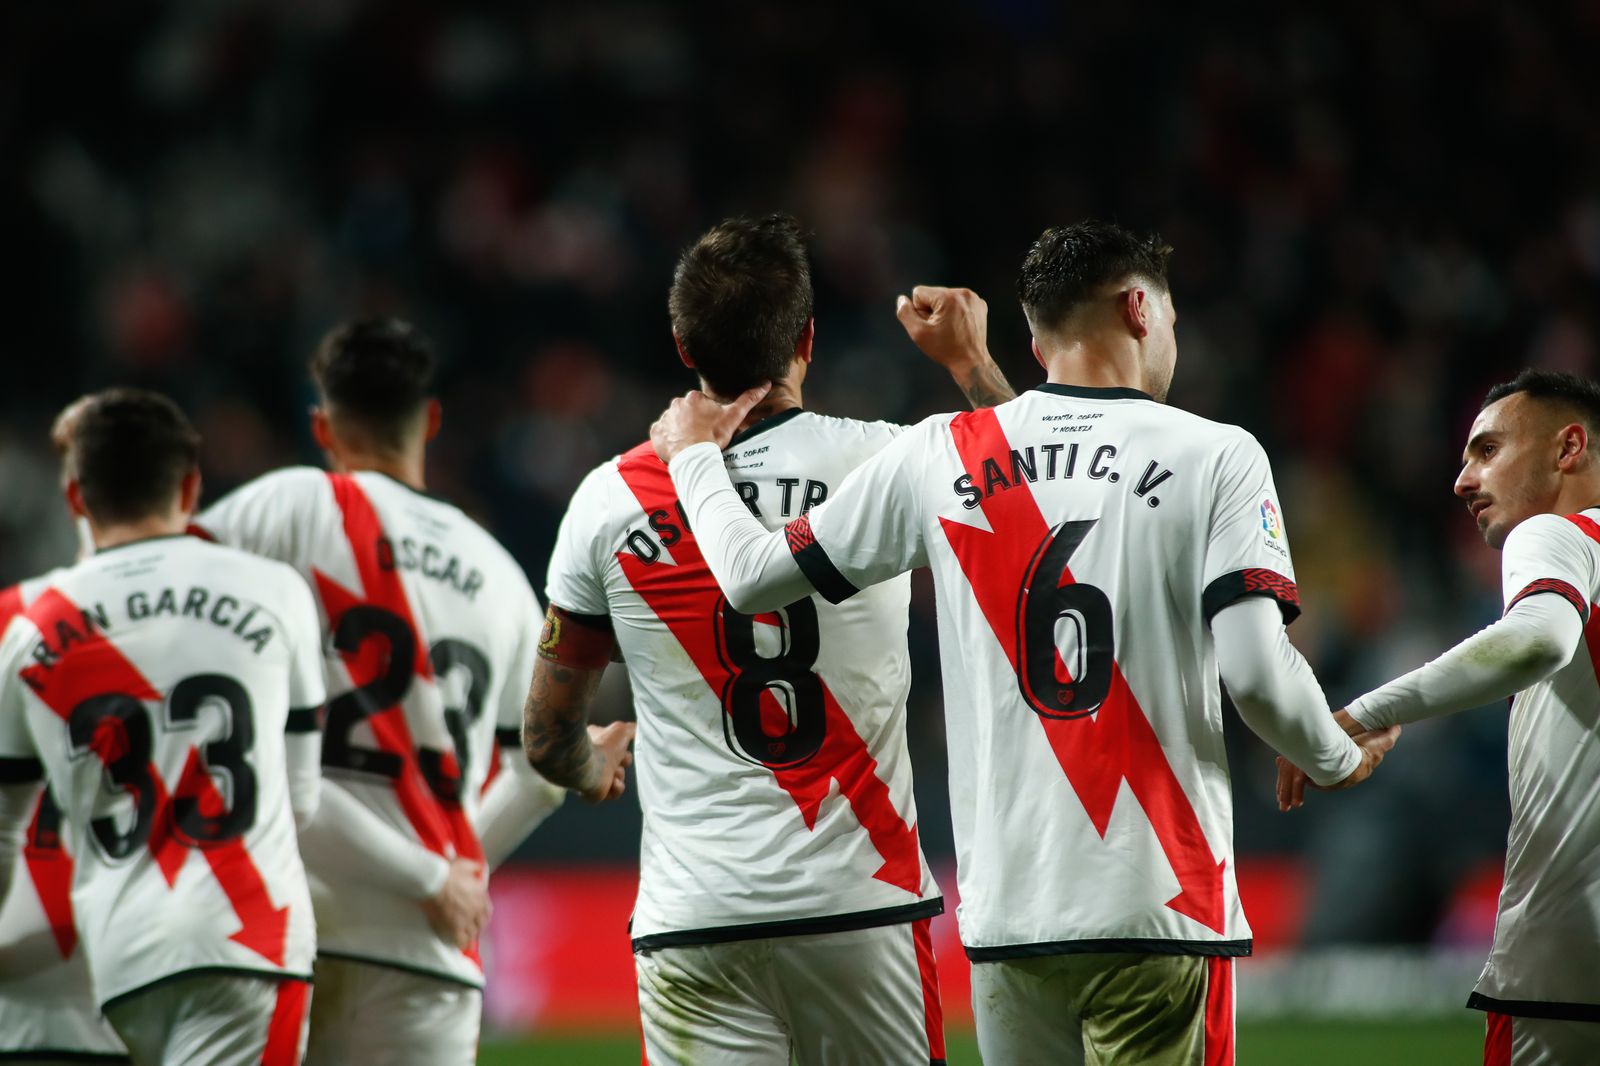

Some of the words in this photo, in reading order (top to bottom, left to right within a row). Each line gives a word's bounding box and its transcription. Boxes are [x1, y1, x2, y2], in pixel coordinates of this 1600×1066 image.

[953, 443, 1080, 510] SANTI
[1086, 444, 1120, 483] C.
[1132, 459, 1174, 508] V.
[713, 590, 827, 770] 8
[1015, 518, 1115, 721] 6
[66, 672, 258, 869] 33
